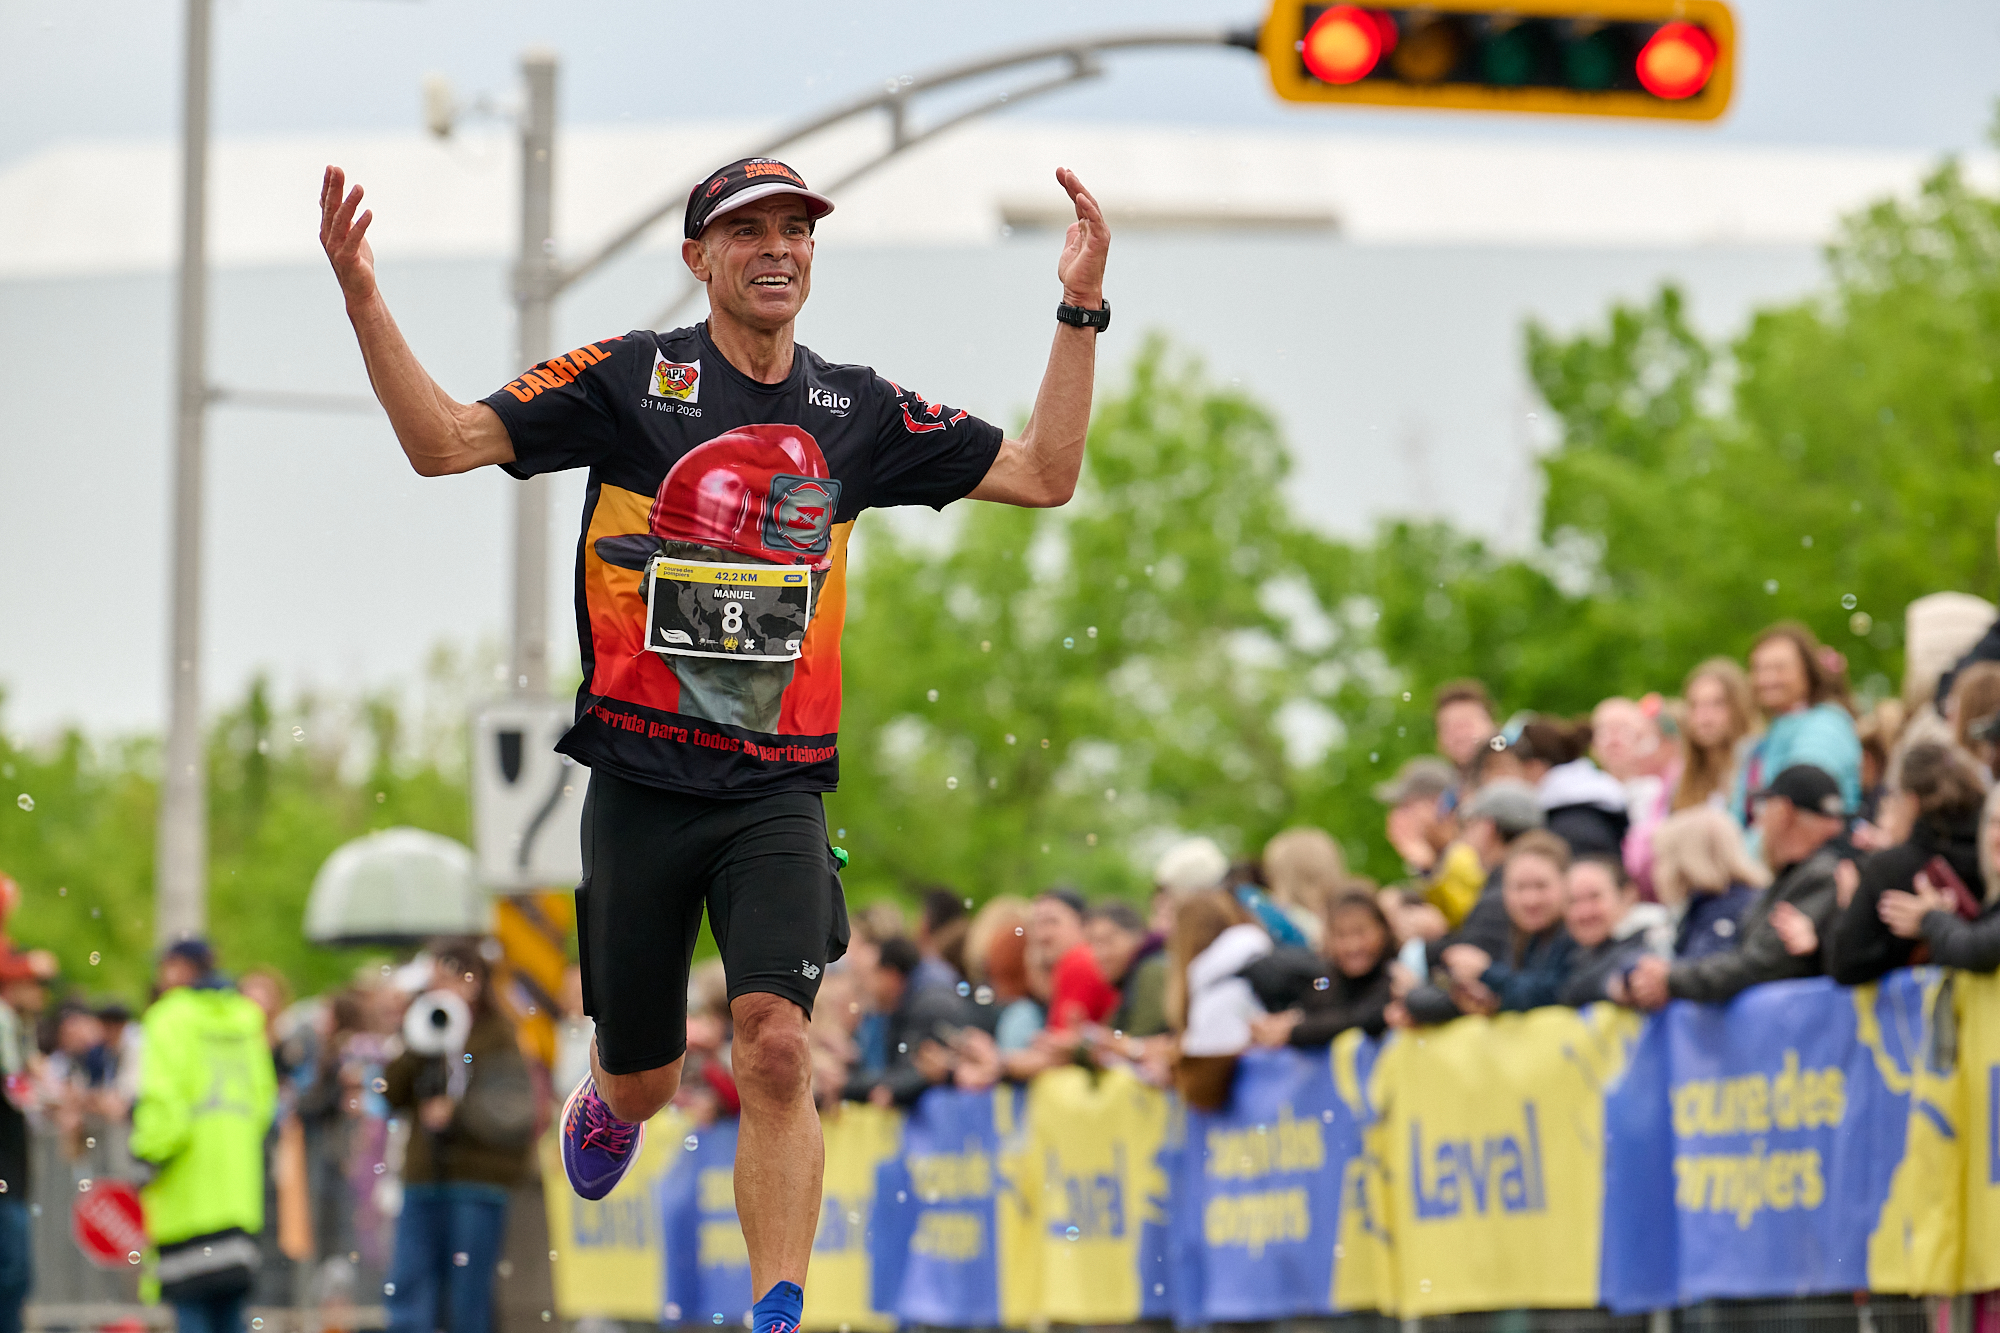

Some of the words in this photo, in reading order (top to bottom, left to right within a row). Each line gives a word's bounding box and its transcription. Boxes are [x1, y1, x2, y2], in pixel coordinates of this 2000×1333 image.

[503, 344, 612, 403] CABRAL
[640, 398, 653, 409] 31
[656, 401, 675, 413] Mai
[676, 404, 702, 418] 2026
[808, 387, 851, 409] Kälo
[715, 572, 738, 582] 42,2
[741, 573, 758, 582] KM
[713, 589, 756, 600] MANUEL
[721, 601, 743, 634] 8
[648, 721, 688, 743] para
[693, 728, 740, 752] todos
[758, 744, 837, 763] participan
[1407, 1099, 1546, 1222] Laval
